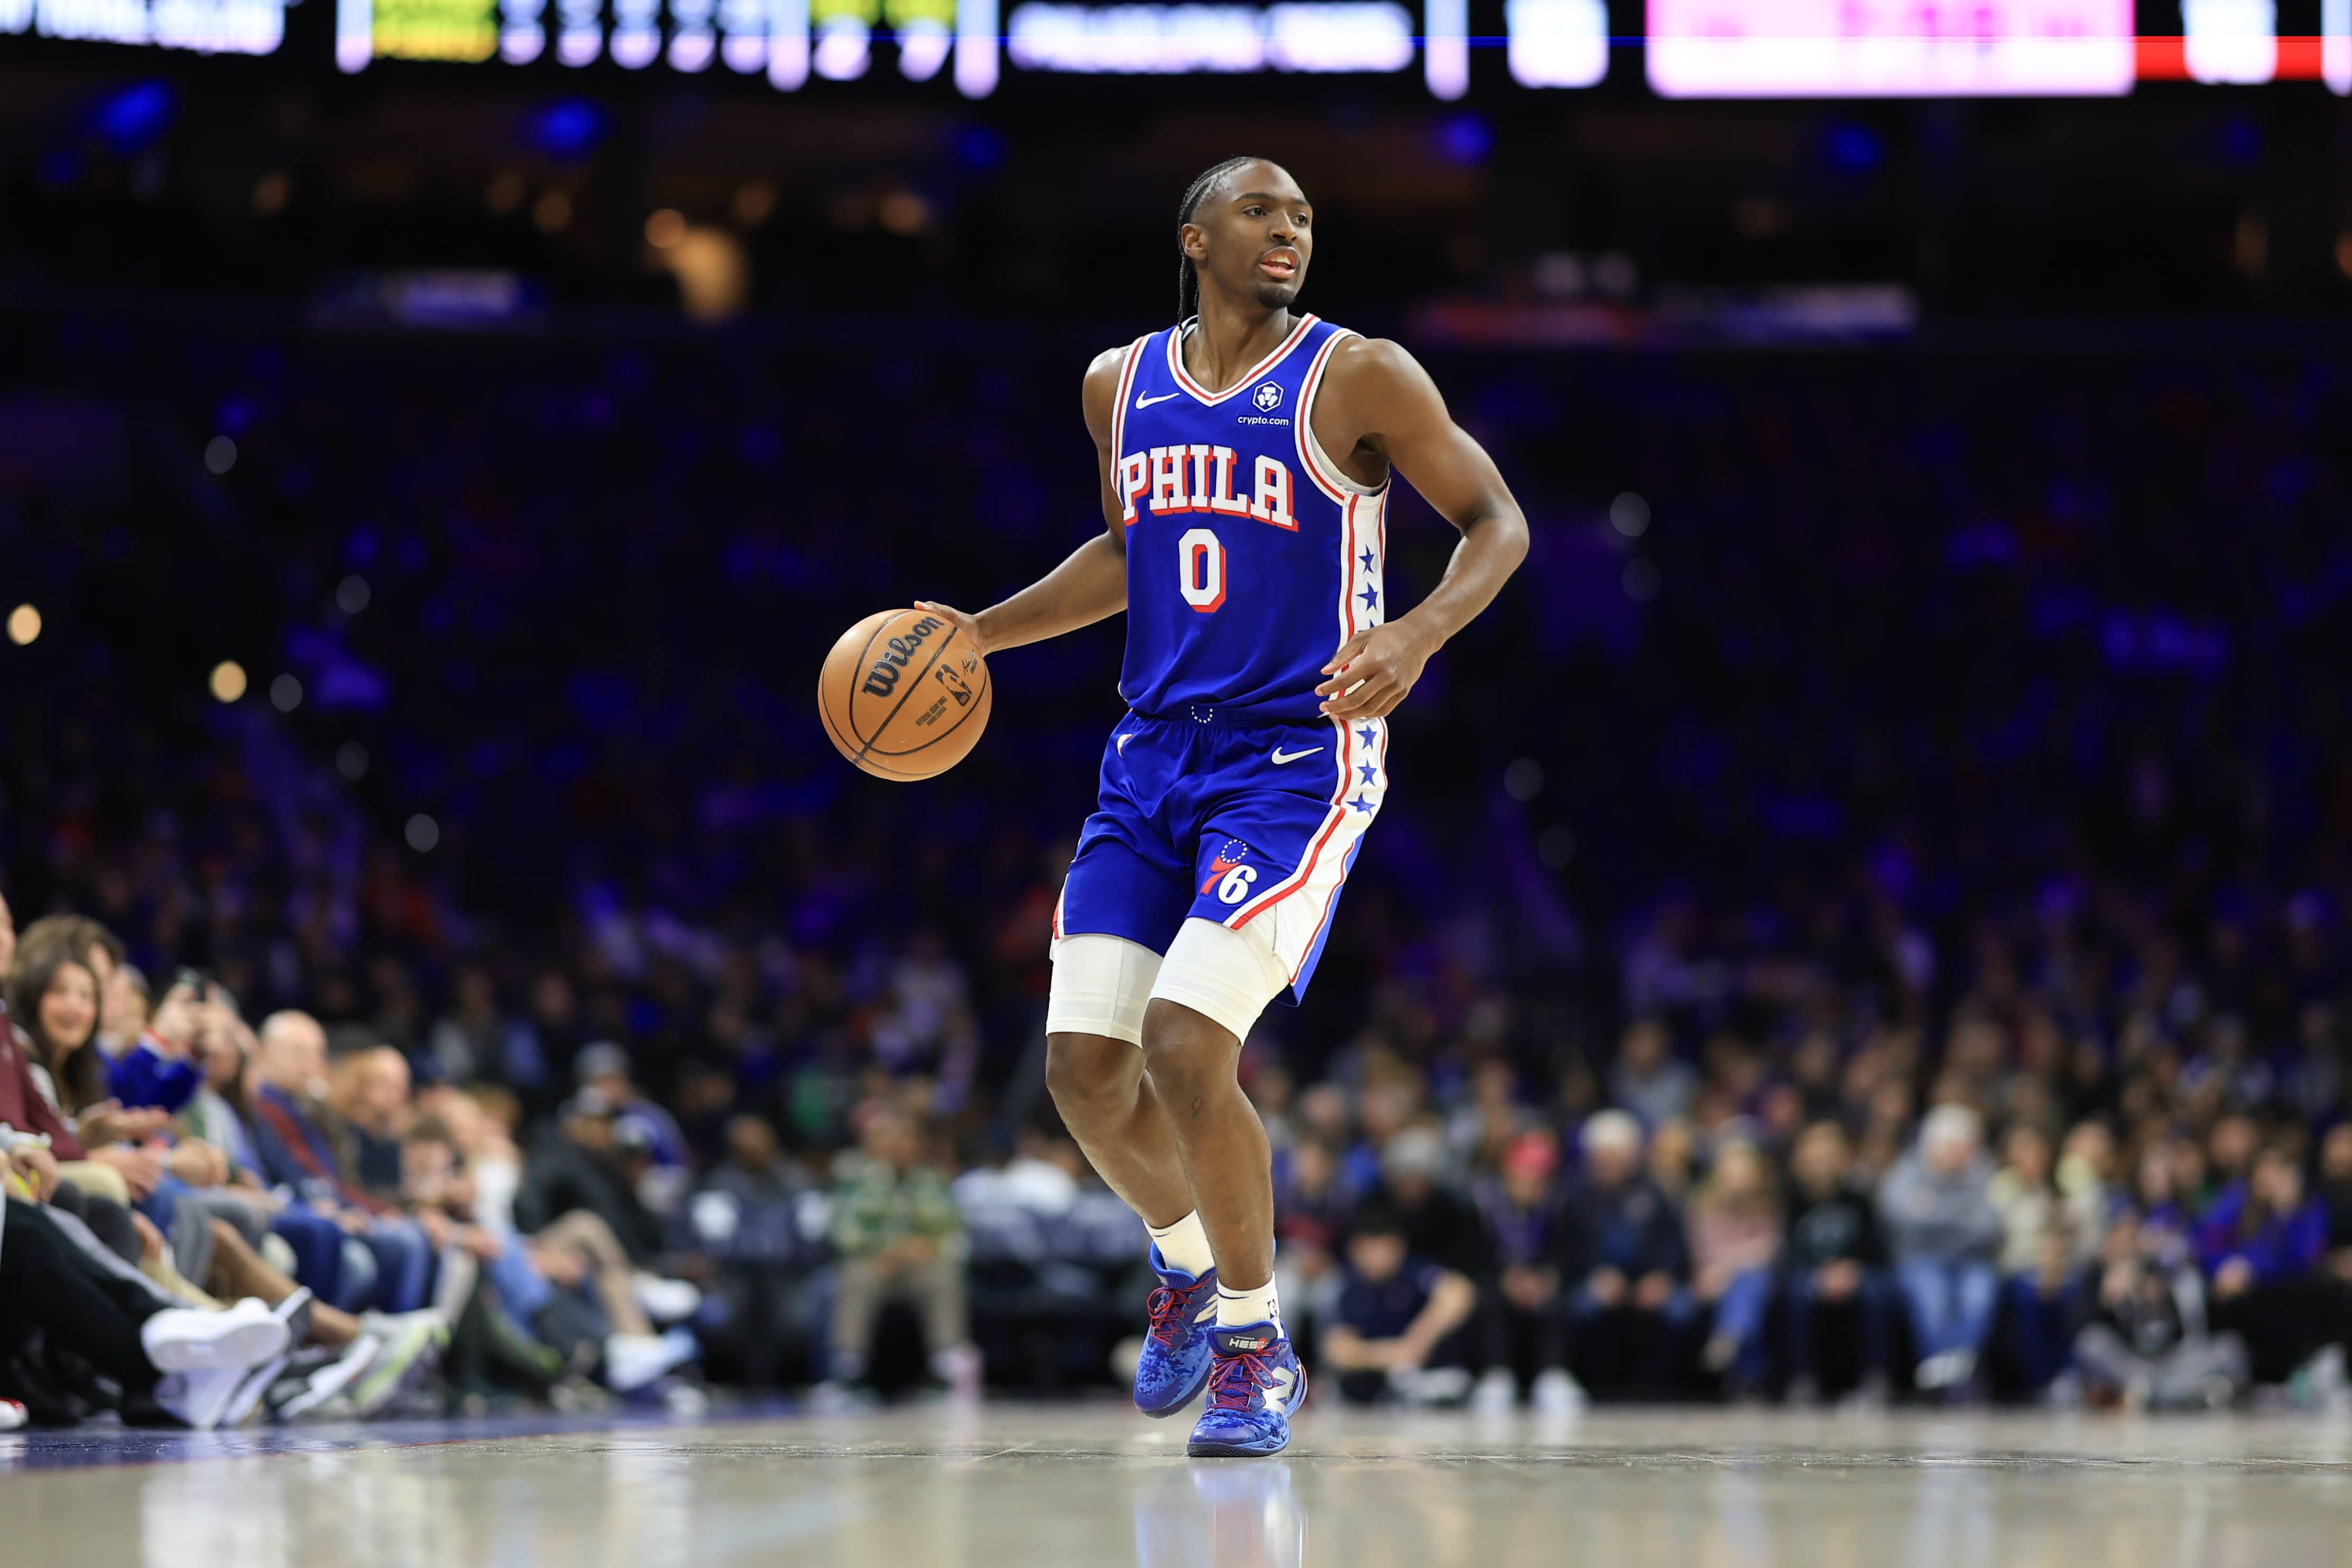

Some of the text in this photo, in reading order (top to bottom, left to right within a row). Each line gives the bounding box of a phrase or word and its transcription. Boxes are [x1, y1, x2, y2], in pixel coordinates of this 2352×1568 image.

[1238, 416, 1289, 426] crypto.com
[1120, 445, 1298, 532] PHILA
[1179, 529, 1225, 613] 0
[862, 616, 945, 698] Wilson
[1201, 855, 1257, 904] 76
